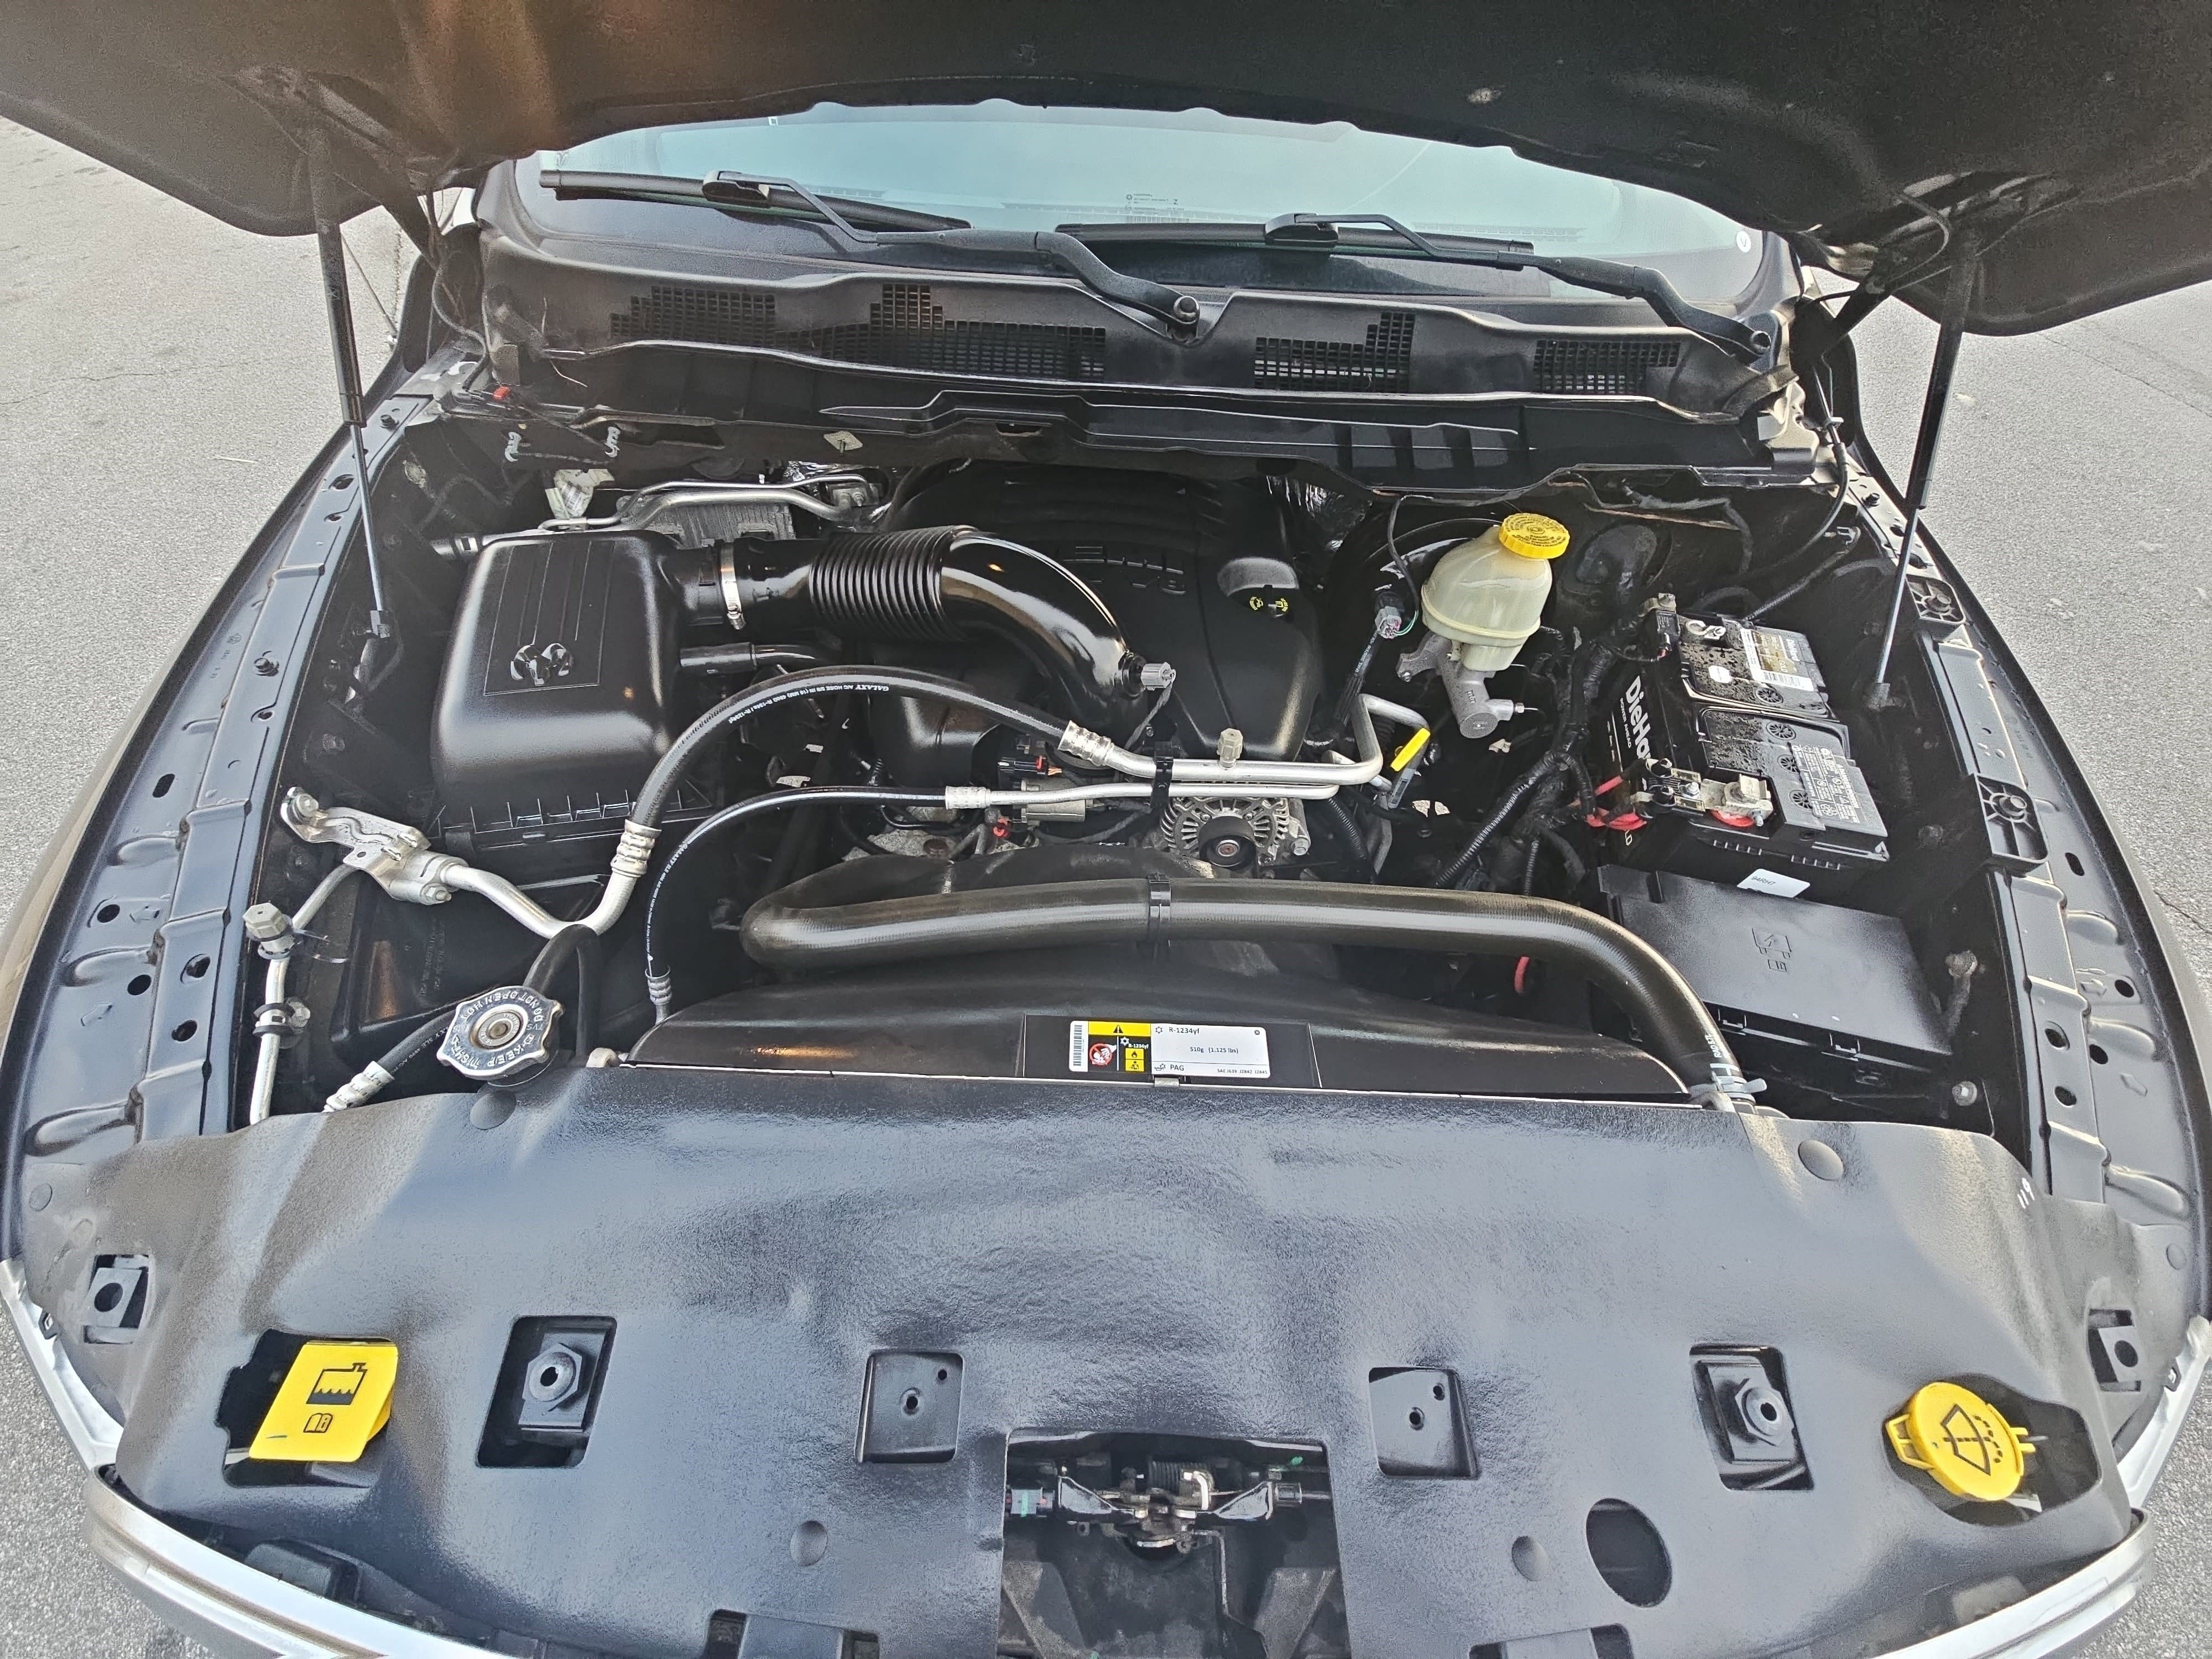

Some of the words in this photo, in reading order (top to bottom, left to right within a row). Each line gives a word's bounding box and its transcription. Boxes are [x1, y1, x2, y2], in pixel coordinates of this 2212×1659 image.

[855, 684, 889, 692] GALAXY
[1626, 675, 1651, 759] DieHa
[1169, 1027, 1199, 1035] R-1234yf
[487, 1044, 525, 1067] KEEP
